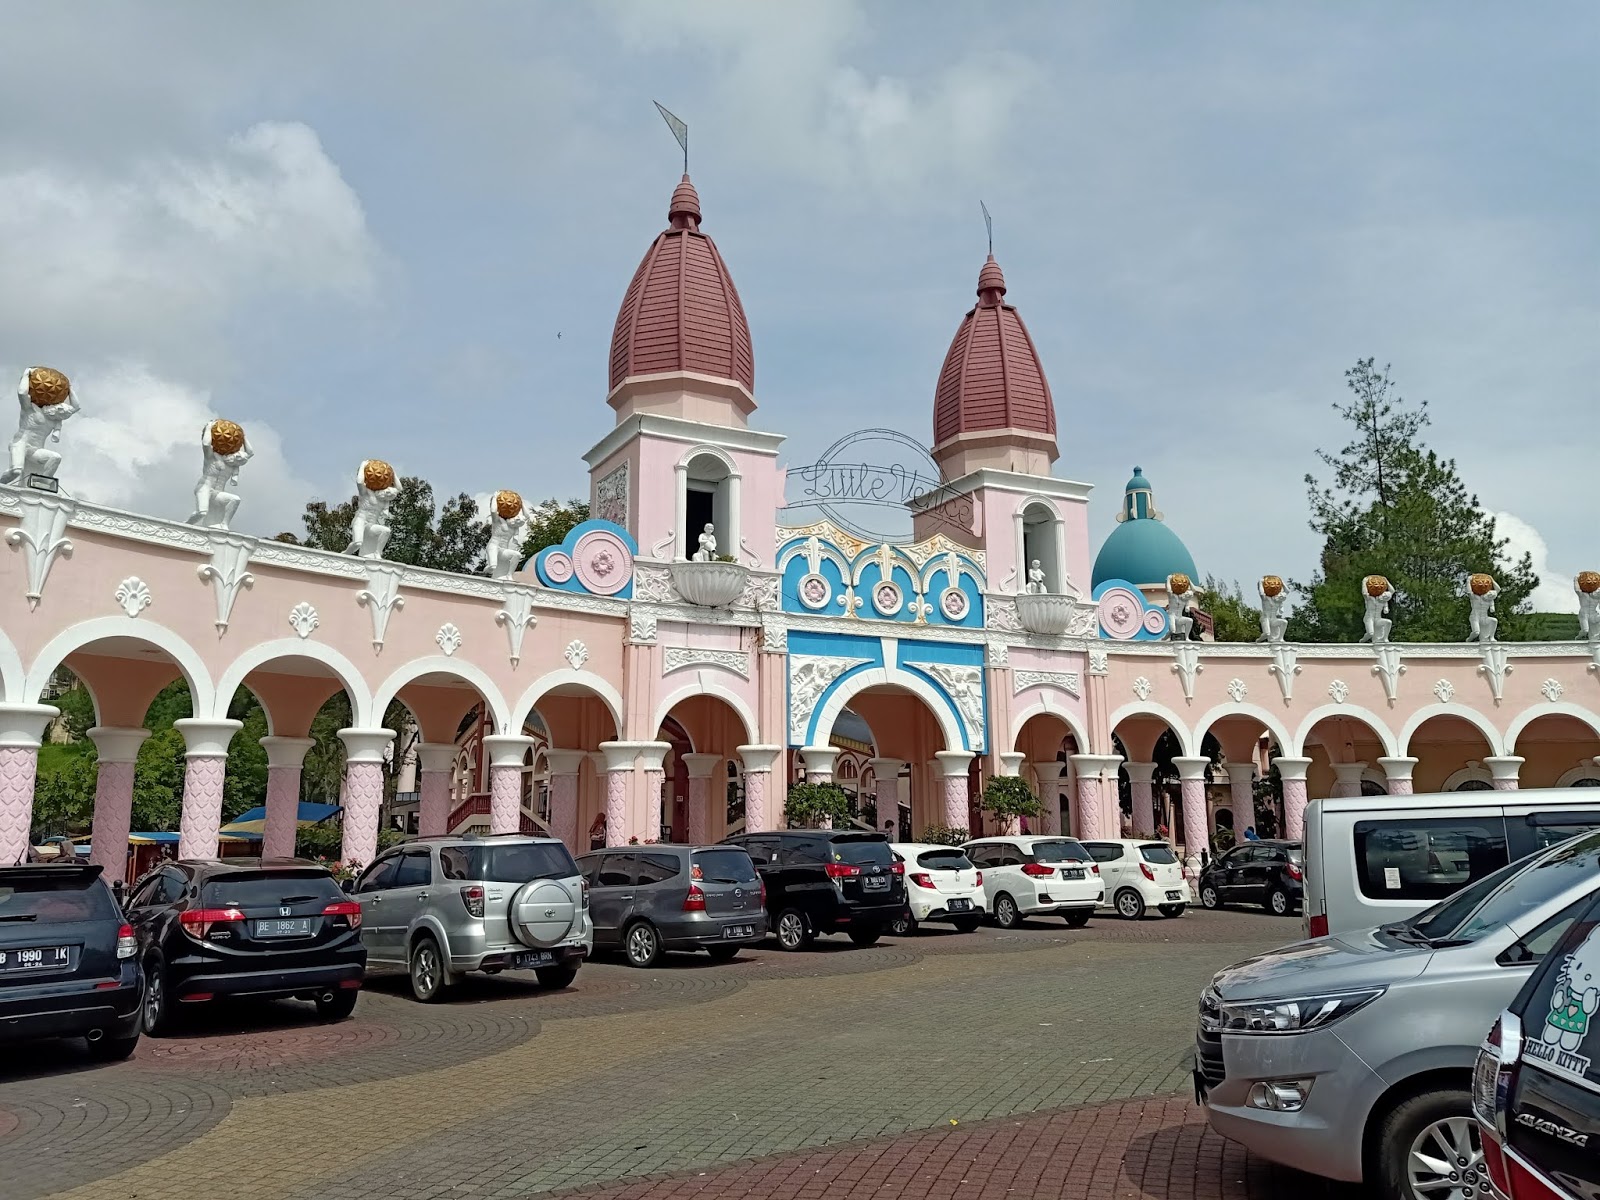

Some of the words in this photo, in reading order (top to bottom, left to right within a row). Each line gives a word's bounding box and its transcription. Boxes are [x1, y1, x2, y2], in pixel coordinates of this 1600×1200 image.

[801, 459, 887, 499] Little
[890, 463, 971, 523] Venice
[259, 921, 270, 932] BE
[276, 920, 295, 931] 1862
[301, 920, 308, 930] A
[17, 949, 42, 963] 1990
[54, 948, 67, 960] IK
[1525, 1039, 1555, 1062] HELLO
[1555, 1050, 1588, 1074] KITTY
[1514, 1113, 1589, 1147] AVANZA
